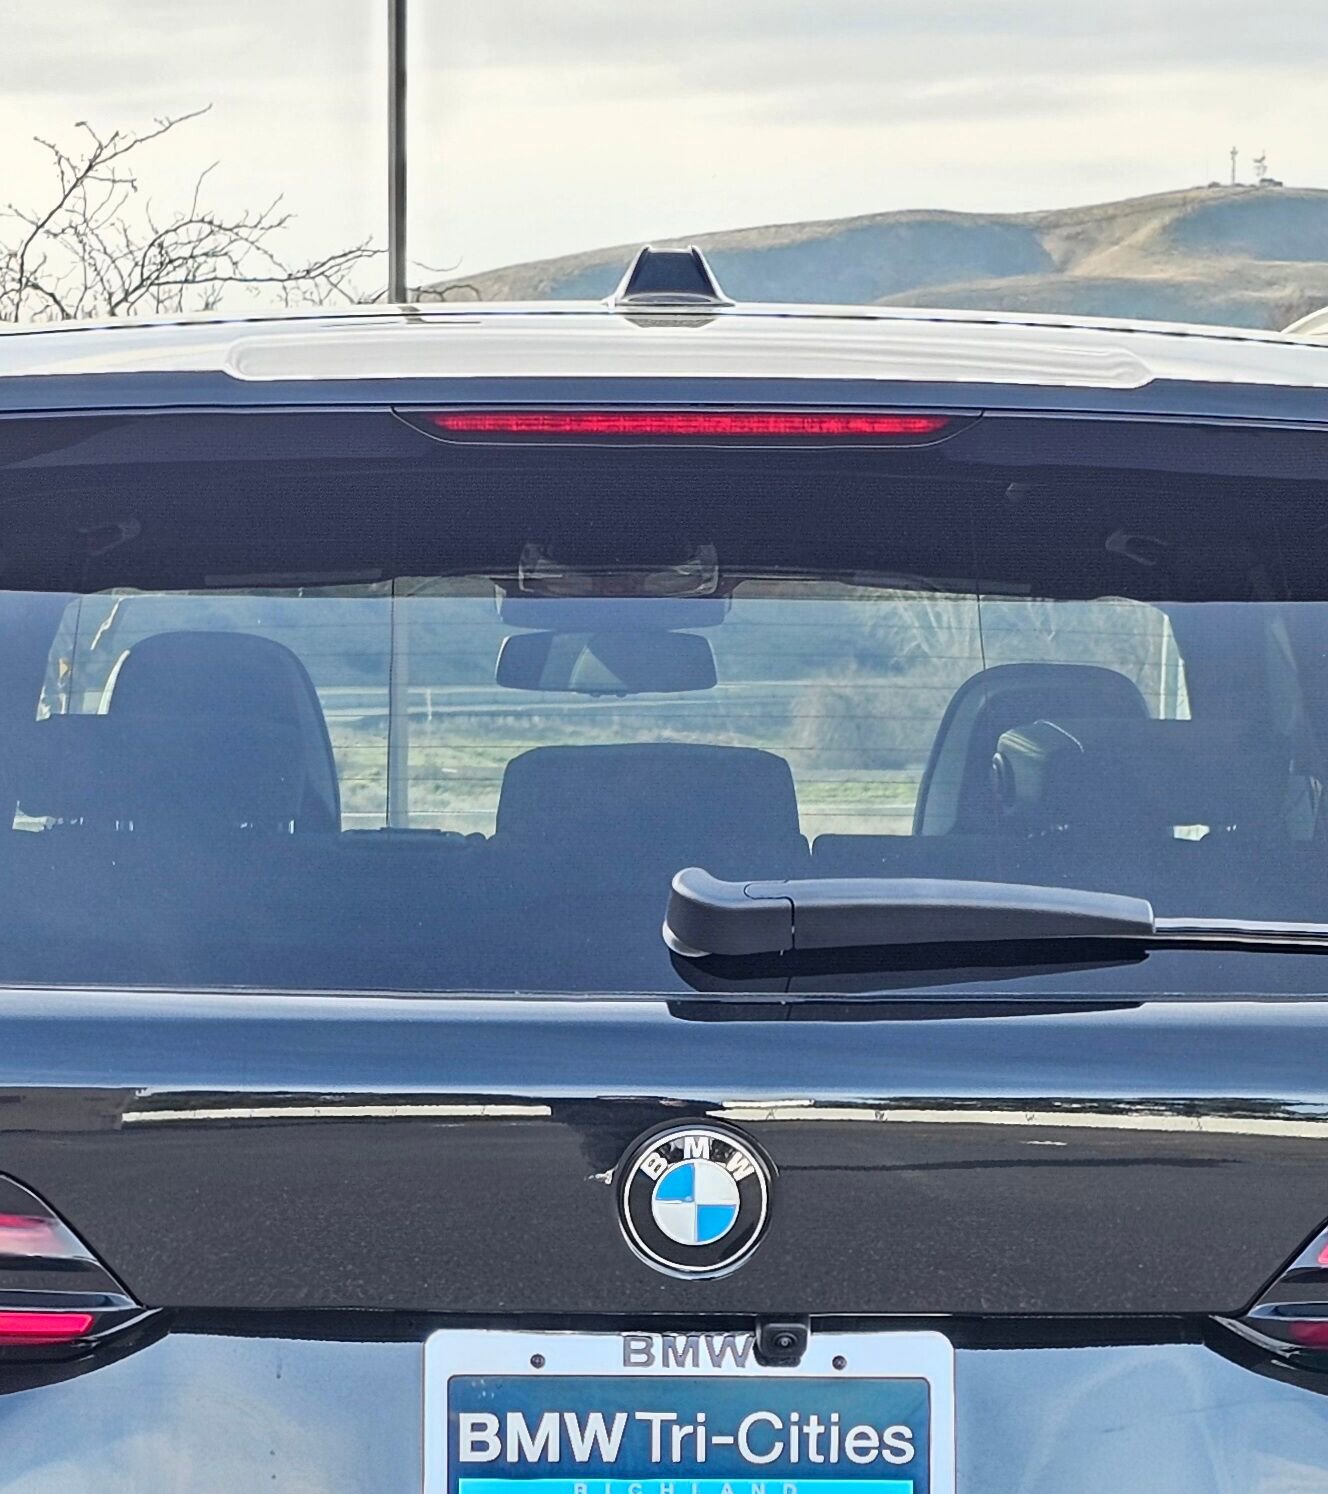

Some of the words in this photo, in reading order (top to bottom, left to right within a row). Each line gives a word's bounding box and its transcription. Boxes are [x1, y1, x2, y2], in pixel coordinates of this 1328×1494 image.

[641, 1136, 755, 1181] BMW
[623, 1335, 755, 1368] BMW
[458, 1412, 628, 1463] BMW
[635, 1411, 914, 1465] Tri-Cities
